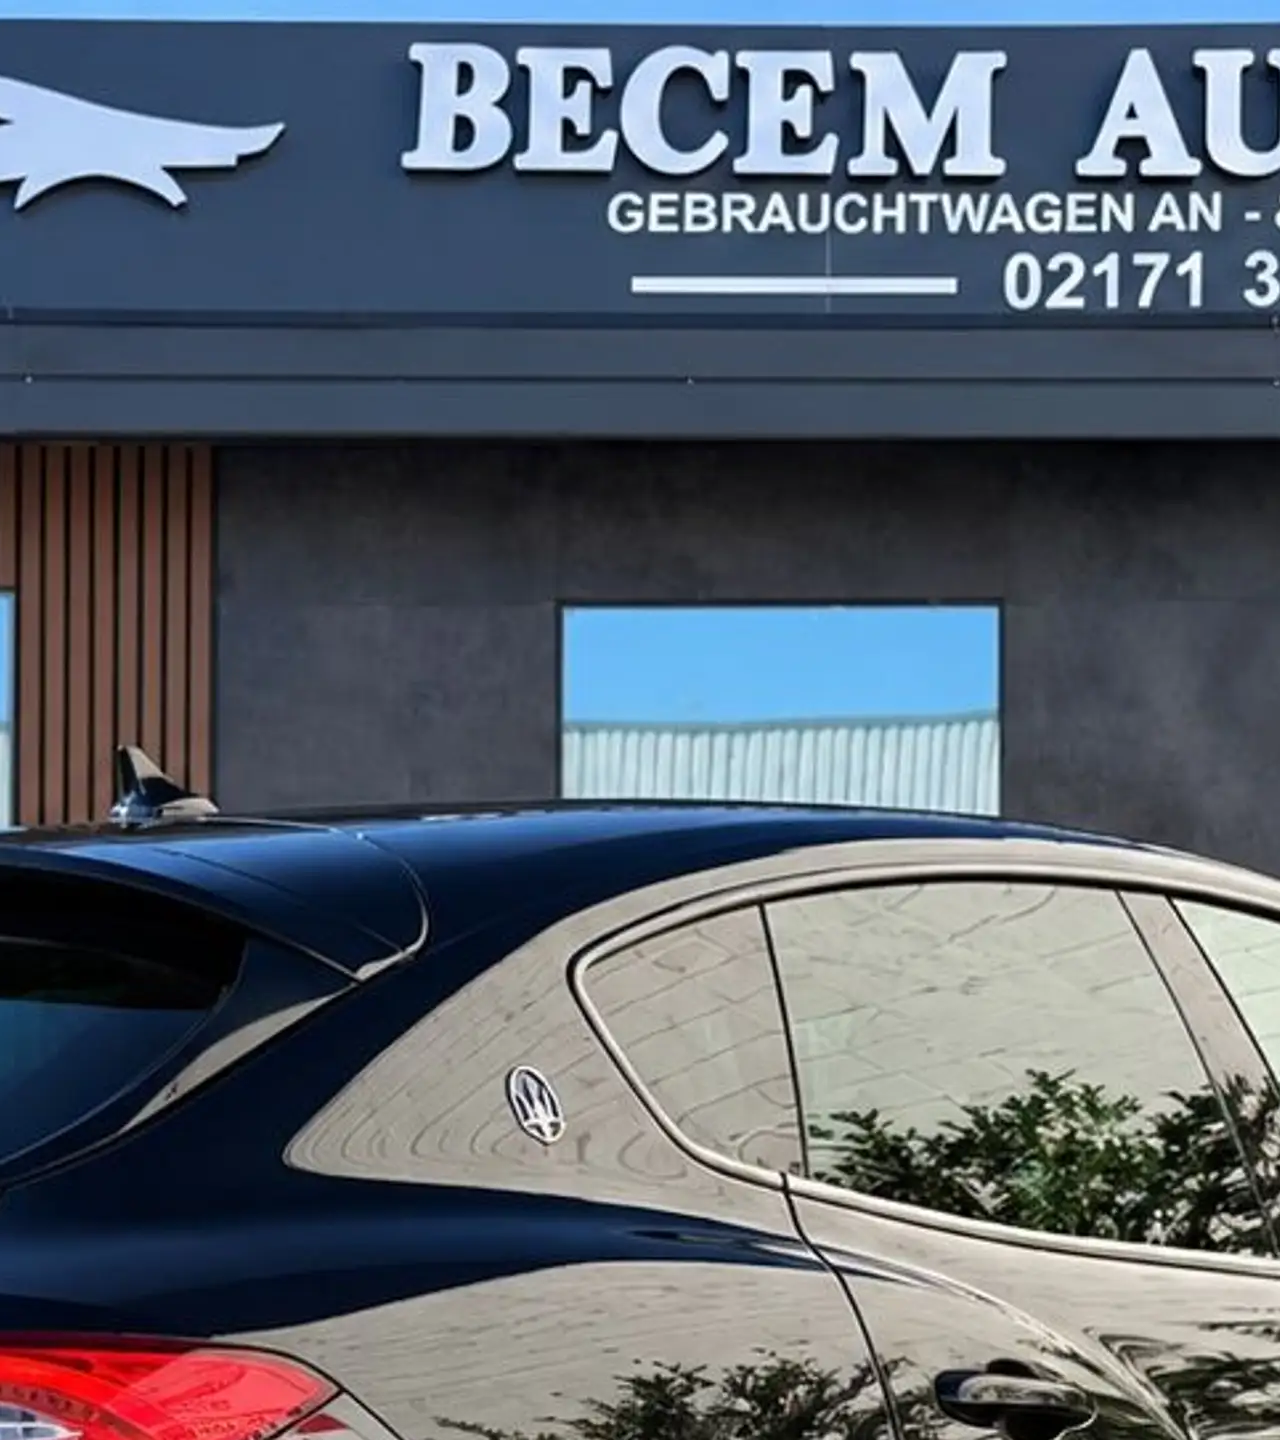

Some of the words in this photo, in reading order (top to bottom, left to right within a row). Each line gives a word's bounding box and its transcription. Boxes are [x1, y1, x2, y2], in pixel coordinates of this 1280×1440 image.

[401, 42, 1007, 177] BECEM
[607, 191, 1134, 234] GEBRAUCHTWAGEN
[1148, 191, 1222, 232] AN
[1004, 251, 1203, 310] 02171
